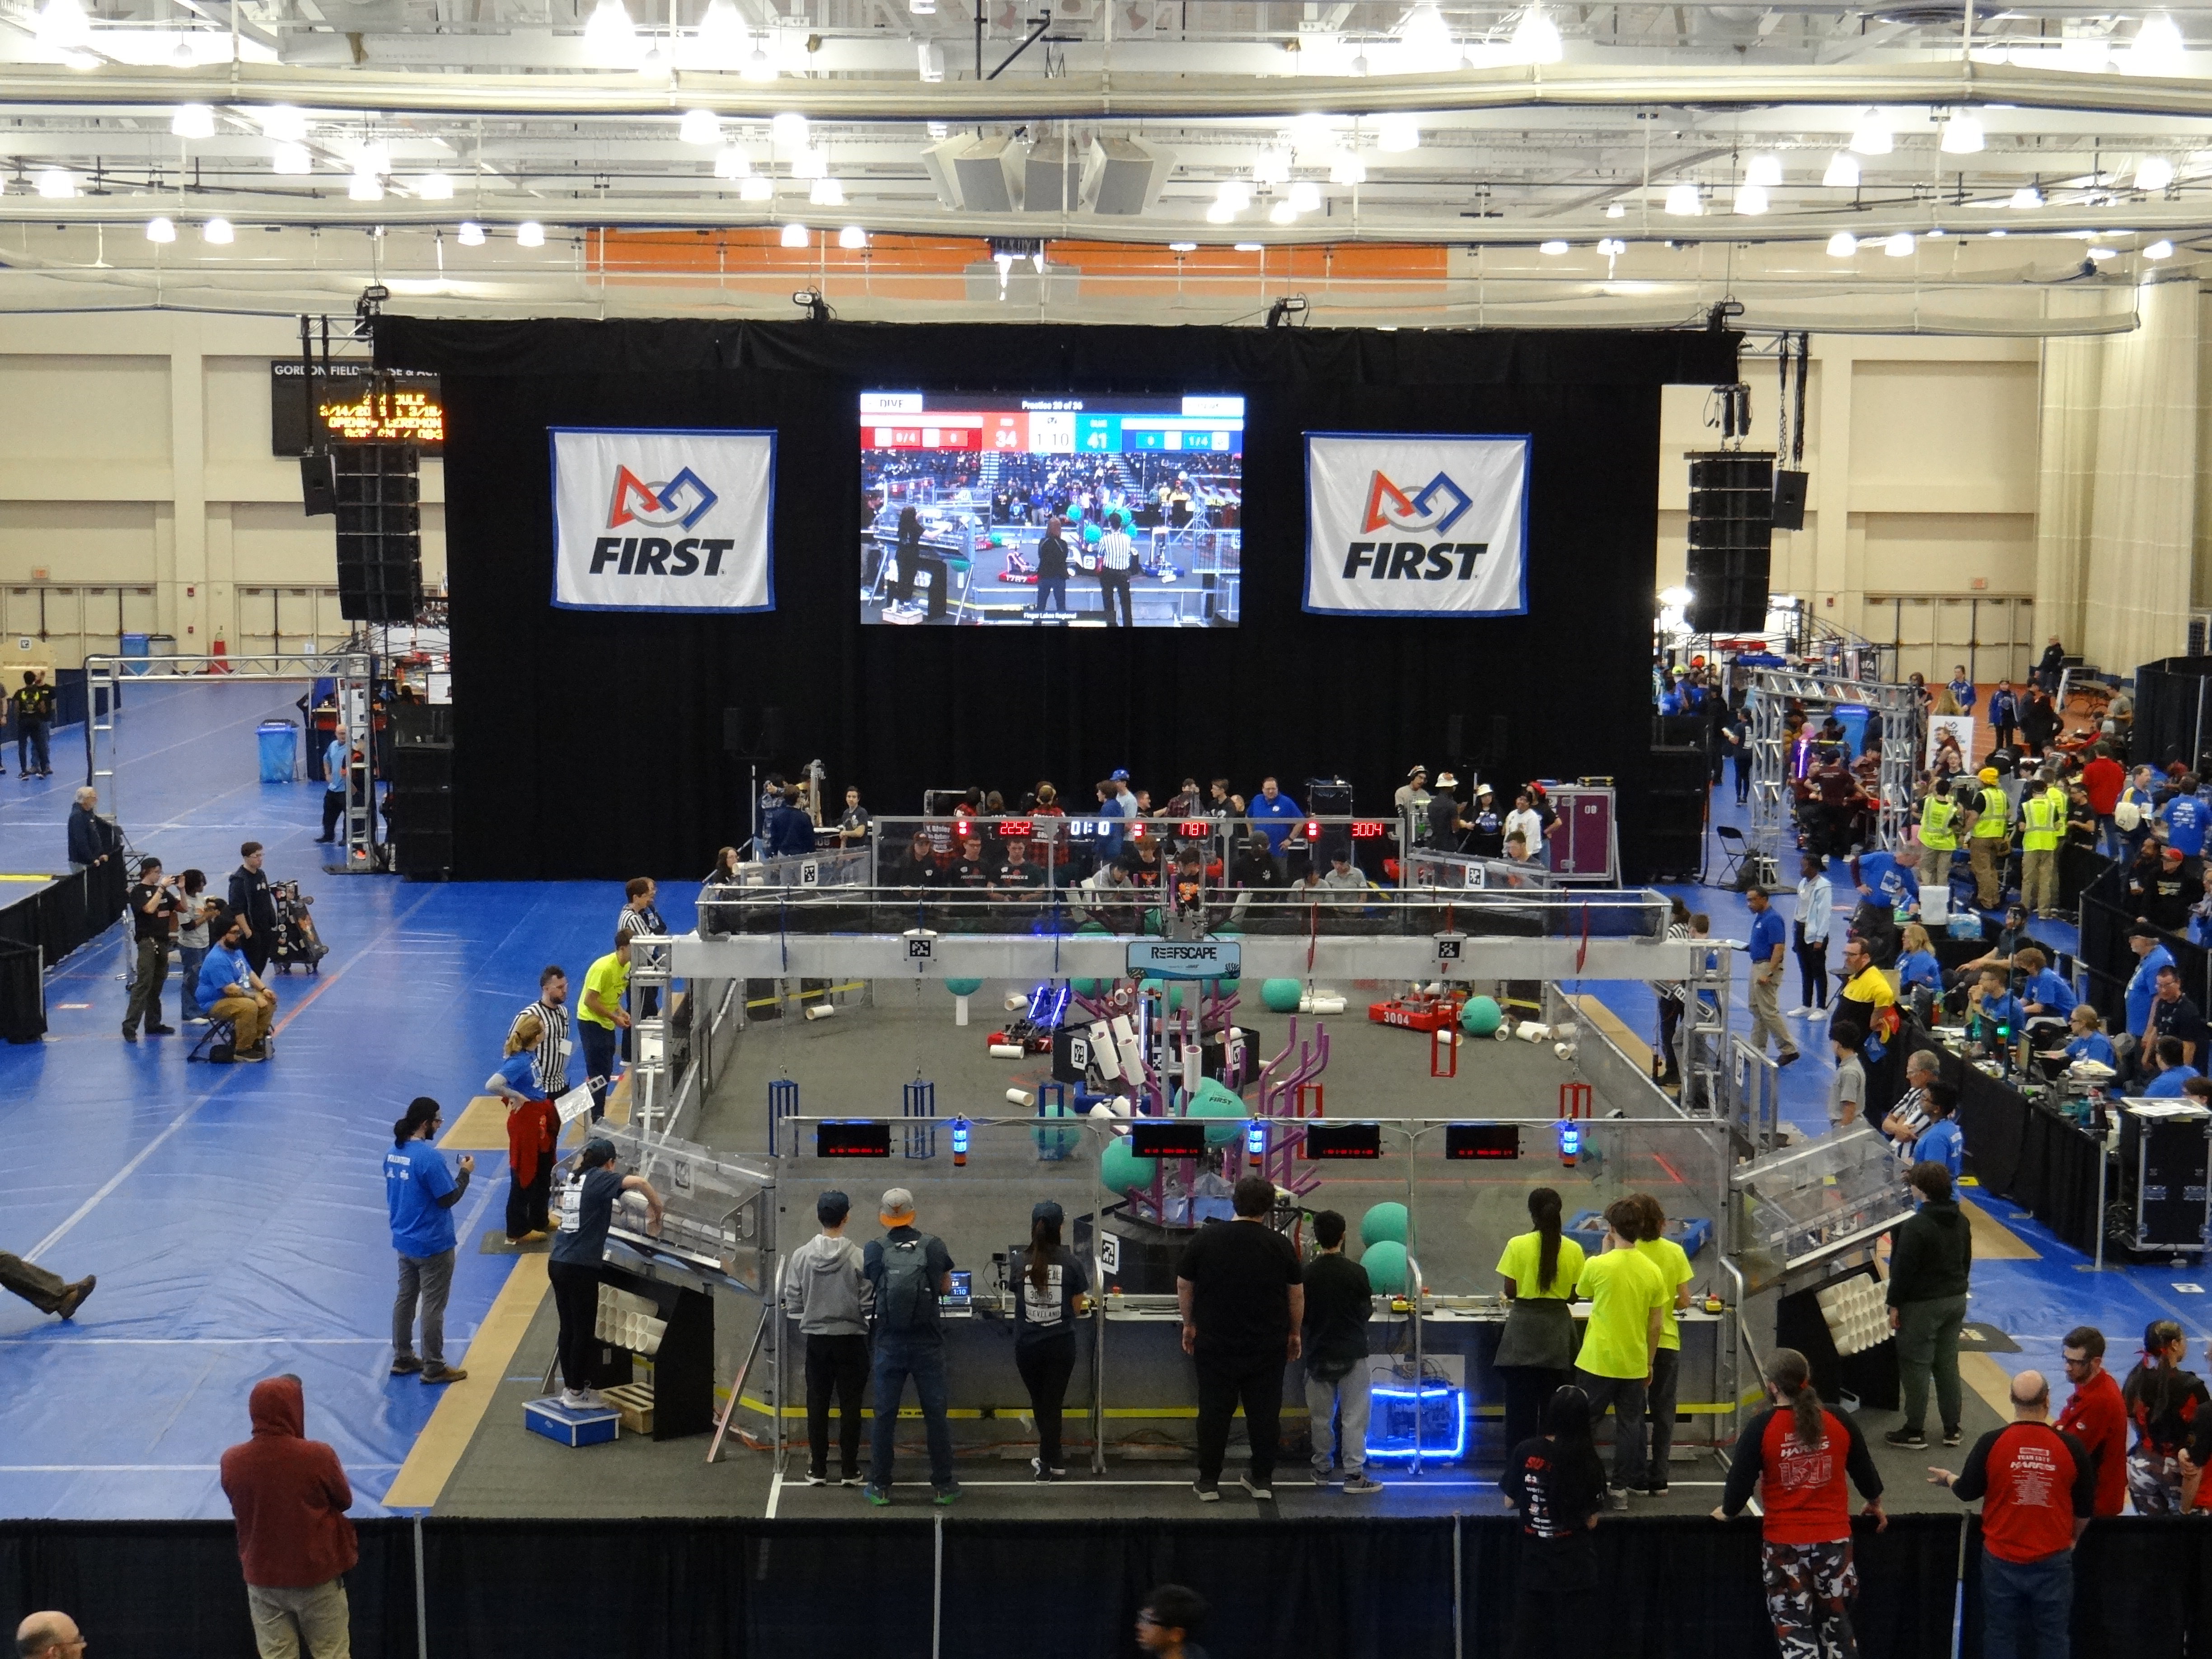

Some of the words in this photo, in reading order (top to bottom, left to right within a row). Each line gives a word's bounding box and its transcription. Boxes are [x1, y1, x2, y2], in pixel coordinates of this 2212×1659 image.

[330, 366, 359, 376] FIELD
[995, 431, 1017, 448] 34
[1087, 432, 1107, 449] 41
[589, 537, 735, 576] FIRST
[1342, 542, 1489, 581] FIRST
[1000, 821, 1030, 834] 2252
[1181, 822, 1207, 835] 1787
[1352, 823, 1382, 836] 3004
[1151, 947, 1217, 959] REEFSCAPE
[1384, 1011, 1409, 1025] 3004
[1209, 1097, 1233, 1105] FIRST
